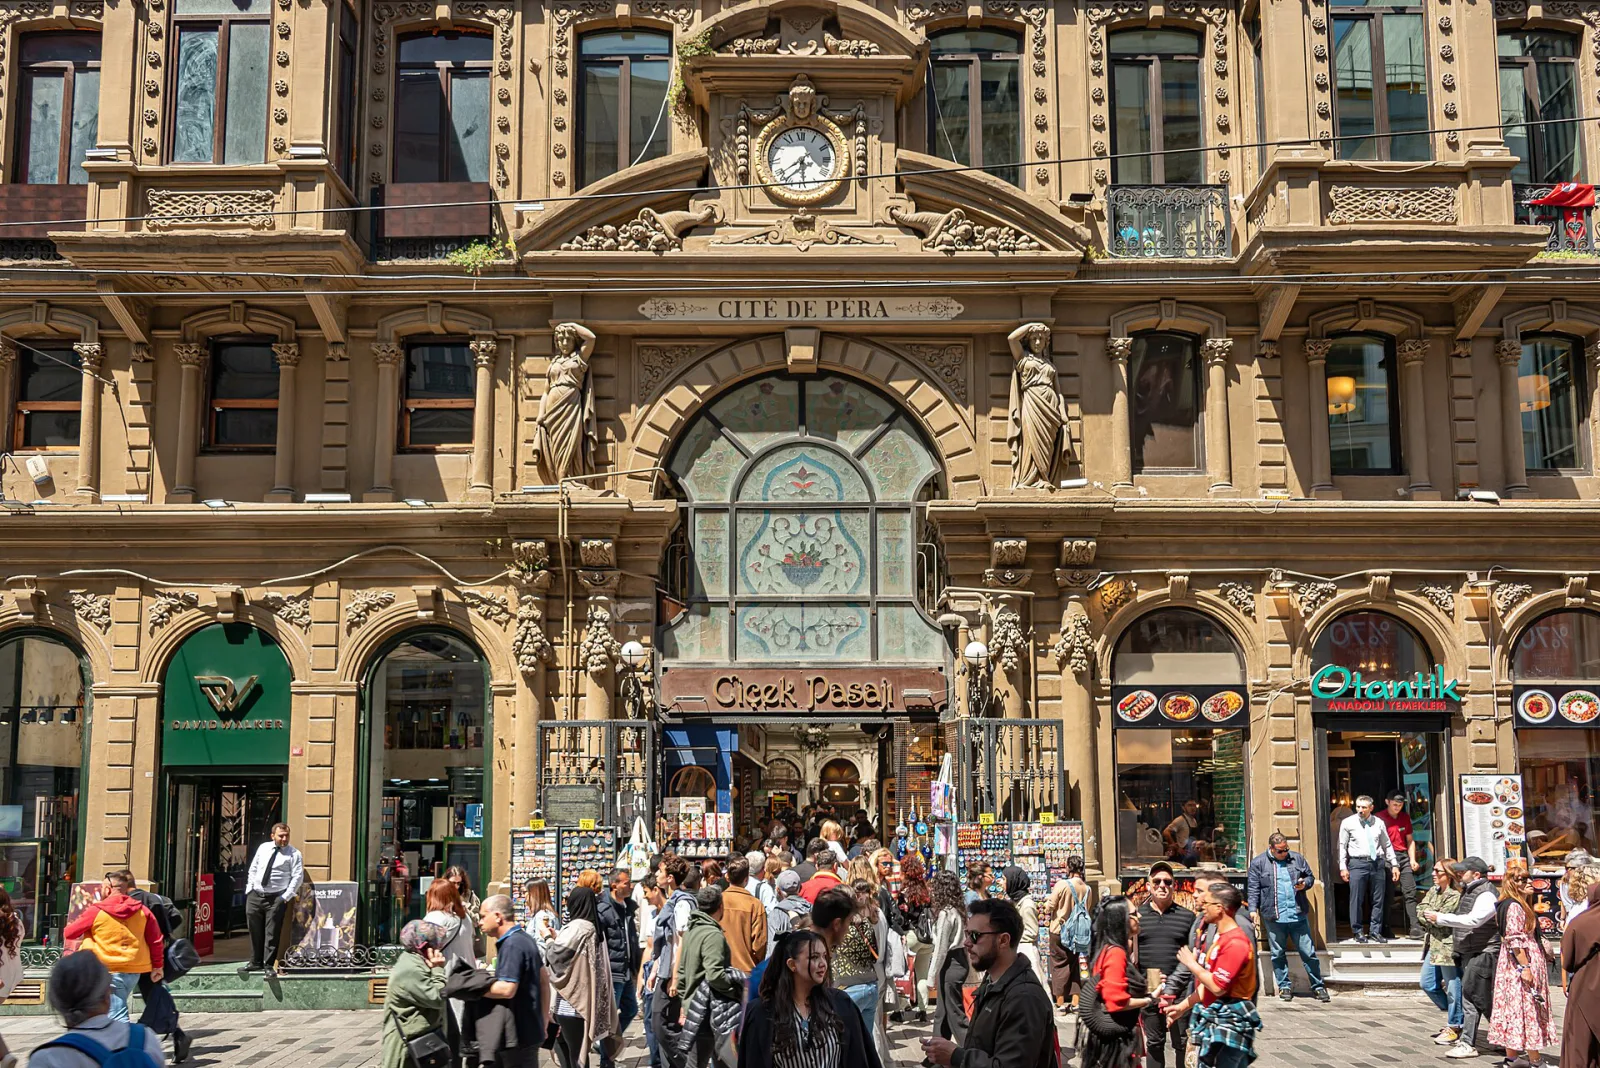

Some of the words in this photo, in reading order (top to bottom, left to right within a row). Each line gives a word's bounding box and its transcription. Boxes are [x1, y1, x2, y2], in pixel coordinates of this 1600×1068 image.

[718, 298, 777, 318] CITÉ
[786, 300, 817, 318] DE
[826, 298, 890, 318] PÉRA
[1310, 664, 1461, 701] Otantik
[1327, 700, 1385, 711] ANADOLU
